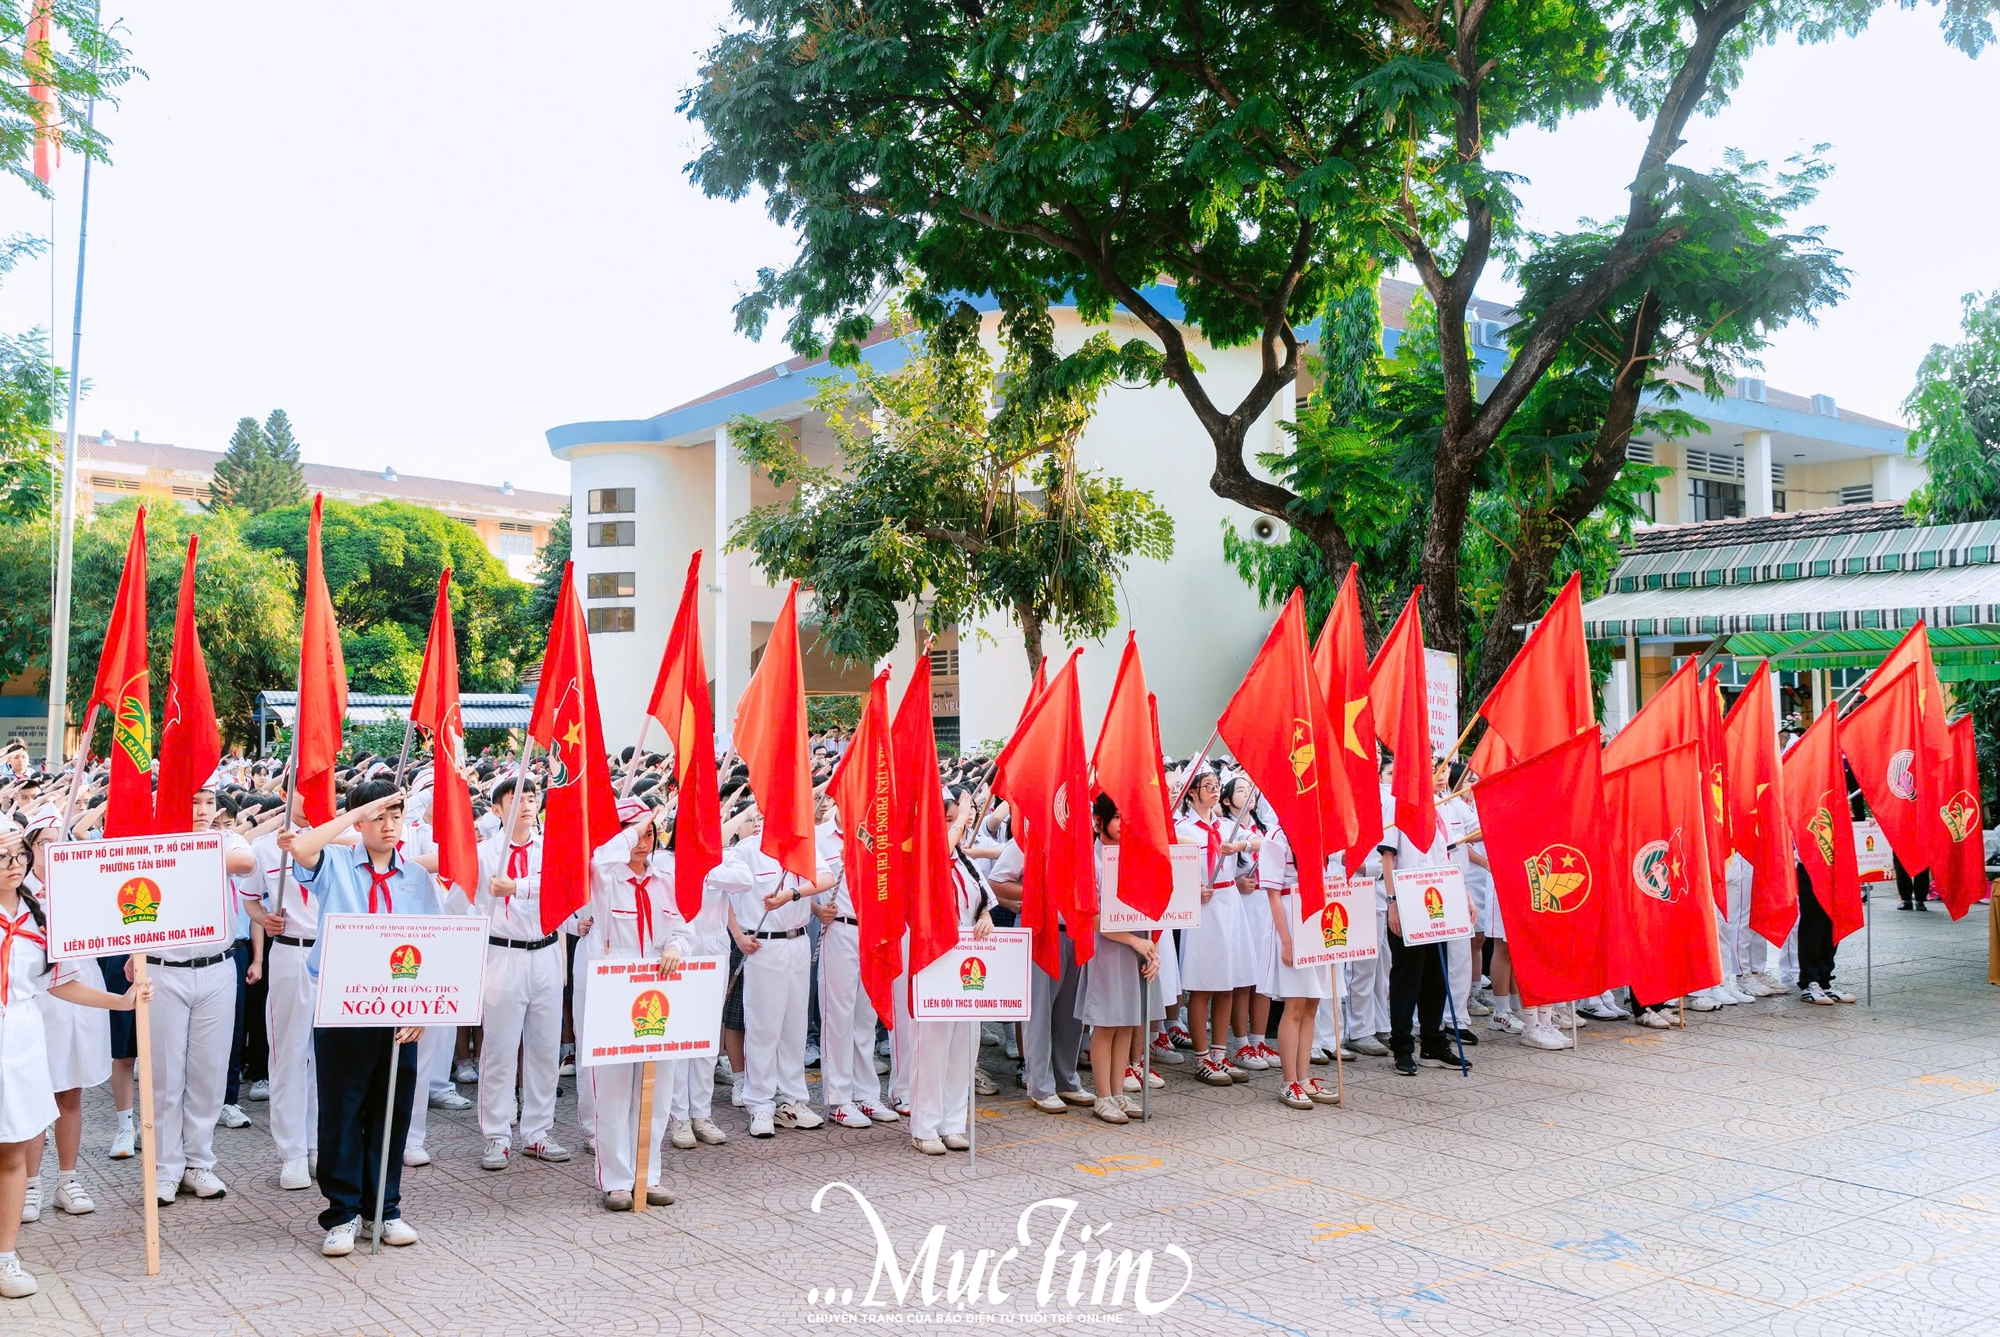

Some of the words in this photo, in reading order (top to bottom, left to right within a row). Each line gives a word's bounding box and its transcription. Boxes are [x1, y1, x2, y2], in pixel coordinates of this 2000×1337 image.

[876, 795, 888, 832] PHONG
[54, 850, 69, 863] ĐỘI
[71, 850, 92, 861] TNTP
[96, 845, 107, 858] HỒ
[110, 846, 123, 857] CHÍ
[126, 846, 151, 856] MINH,
[154, 844, 165, 853] TP.
[167, 840, 178, 852] HỒ
[181, 841, 194, 851] CHÍ
[197, 840, 218, 850] MINH
[100, 860, 135, 873] PHƯỜNG
[138, 858, 153, 870] TÂN
[156, 857, 176, 869] BÌNH
[877, 872, 888, 901] MINH
[64, 938, 85, 951] LIÊN
[88, 935, 104, 951] ĐỘI
[107, 934, 131, 946] THCS
[134, 929, 165, 944] HOÀNG
[169, 929, 187, 940] HOA
[189, 924, 214, 938] THÁM
[597, 964, 609, 976] ĐỘI
[345, 984, 368, 993] LIÊN
[371, 983, 388, 995] ĐỘI
[391, 984, 432, 993] TRƯỜNG
[341, 997, 386, 1016] NGÔ
[391, 995, 459, 1018] QUYỀN
[924, 997, 939, 1008] LIÊN
[941, 997, 952, 1010] ĐỘI
[955, 999, 972, 1008] THCS
[974, 999, 997, 1008] QUANG
[1000, 999, 1022, 1008] TRUNG
[646, 1044, 662, 1053] THCS
